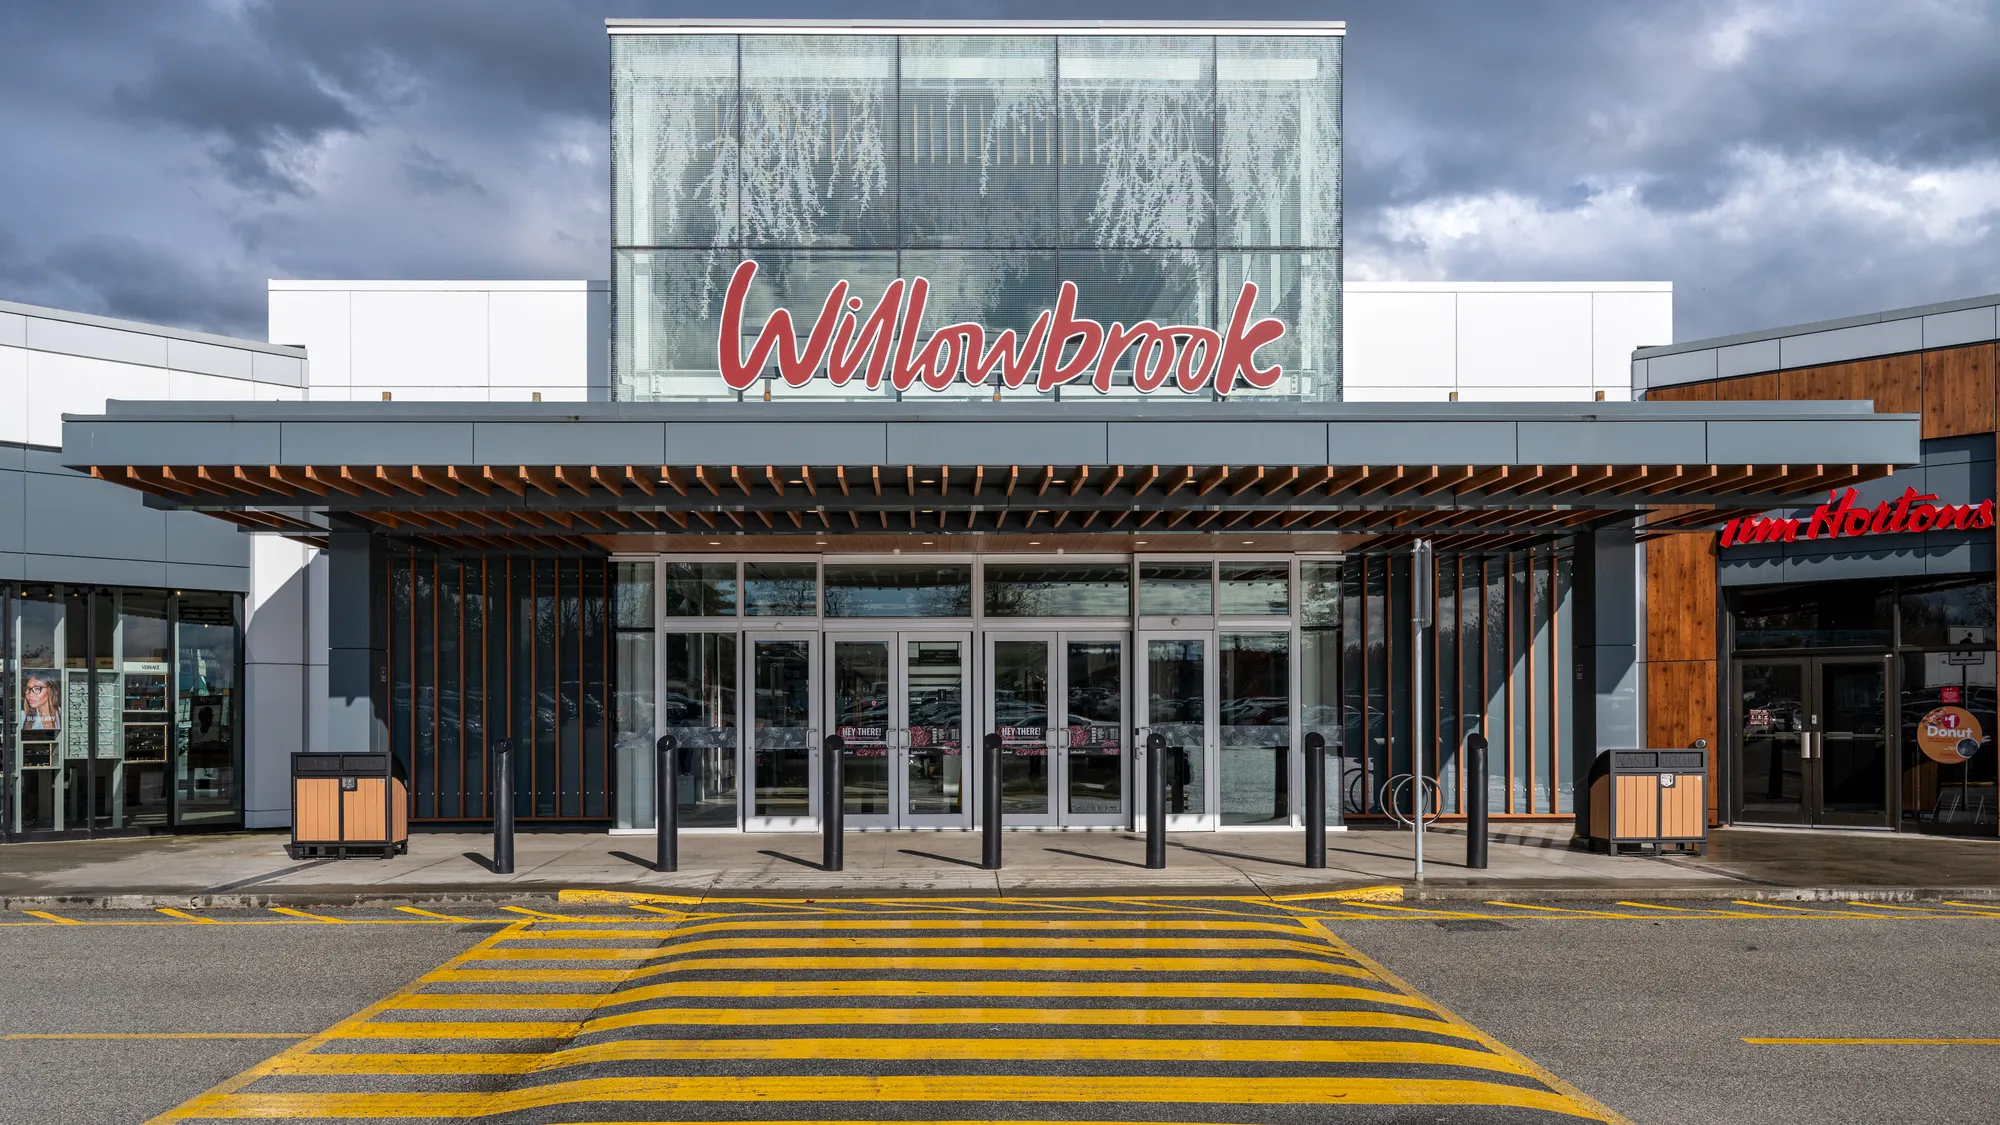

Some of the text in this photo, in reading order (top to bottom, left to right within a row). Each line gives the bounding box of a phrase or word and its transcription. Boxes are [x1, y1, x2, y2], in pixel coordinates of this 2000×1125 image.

[718, 260, 1286, 396] Willowbrook
[1806, 486, 1994, 540] Hortons
[842, 727, 882, 736] HEY THERE!
[1001, 727, 1041, 736] HEY THERE!
[1927, 725, 1973, 739] Donut
[1615, 753, 1656, 767] WASTE
